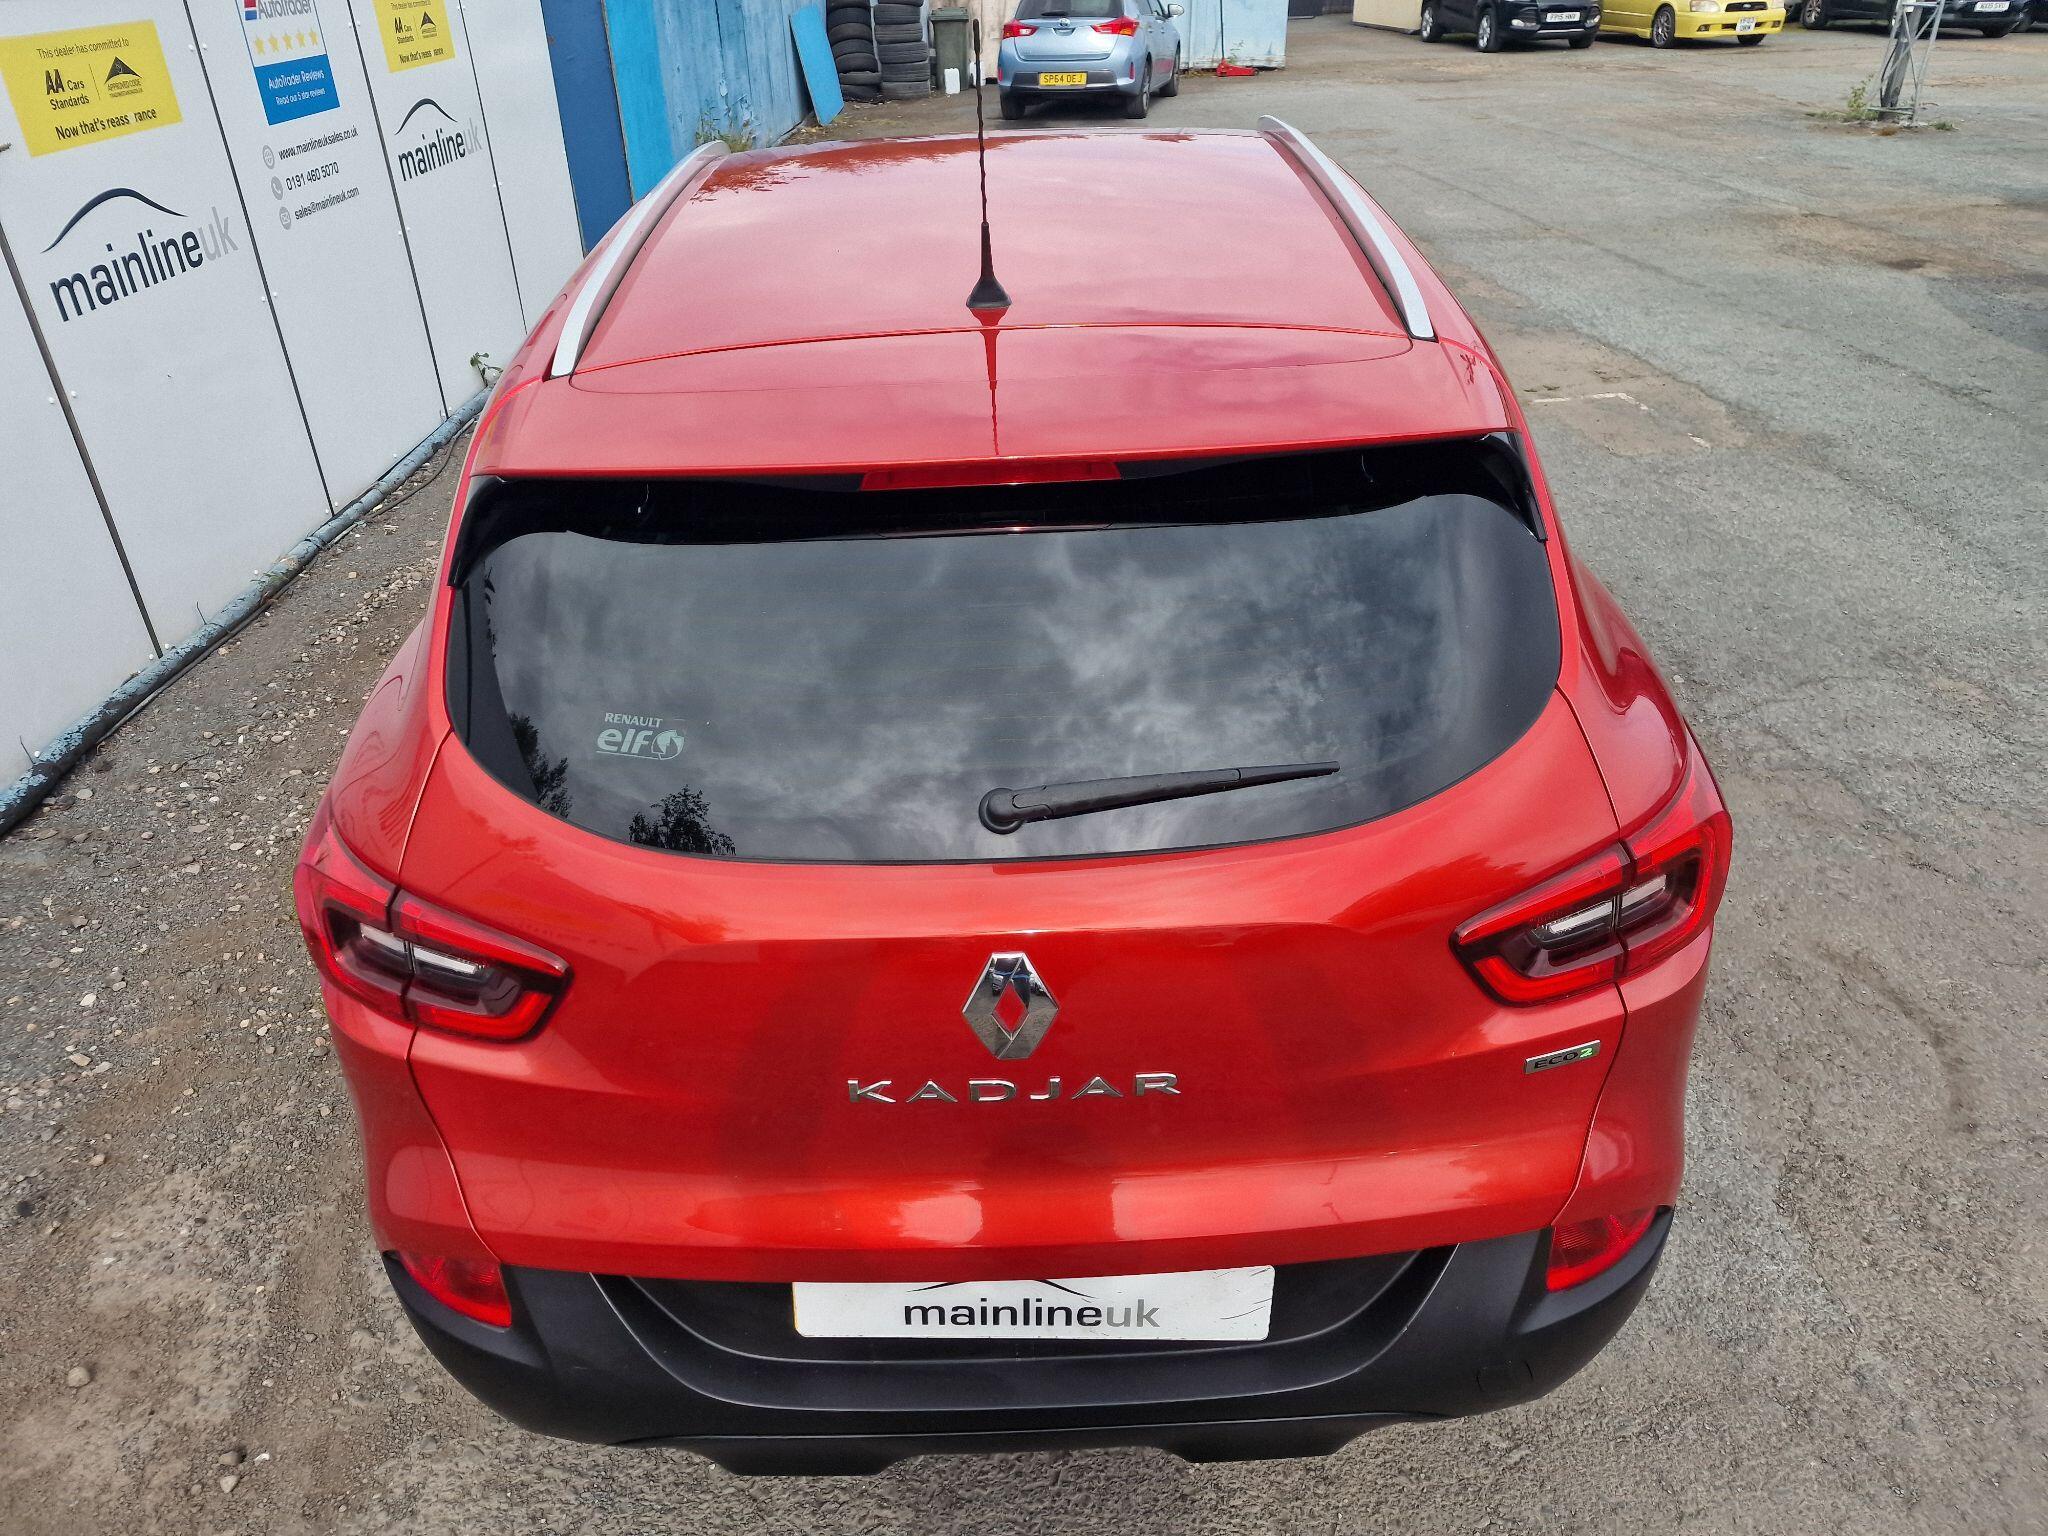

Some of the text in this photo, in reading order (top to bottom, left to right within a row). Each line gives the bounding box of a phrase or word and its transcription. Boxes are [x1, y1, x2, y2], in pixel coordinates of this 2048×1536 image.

[259, 0, 312, 19] AutoTrader
[36, 37, 130, 59] This dealer has committed to
[45, 69, 86, 95] AA Cars
[268, 69, 325, 91] AutoTrader Reviews
[49, 93, 90, 112] Standards
[275, 95, 290, 106] Read
[55, 123, 80, 141] Now
[79, 116, 107, 135] that's
[279, 125, 358, 160] www.mainlineuksales.co.uk
[285, 161, 340, 191] 0191 460 5070
[294, 186, 360, 220] sales@mainlineuk.com
[604, 712, 663, 728] RENAULT
[597, 729, 653, 753] elf
[847, 1072, 1181, 1103] KADJAR
